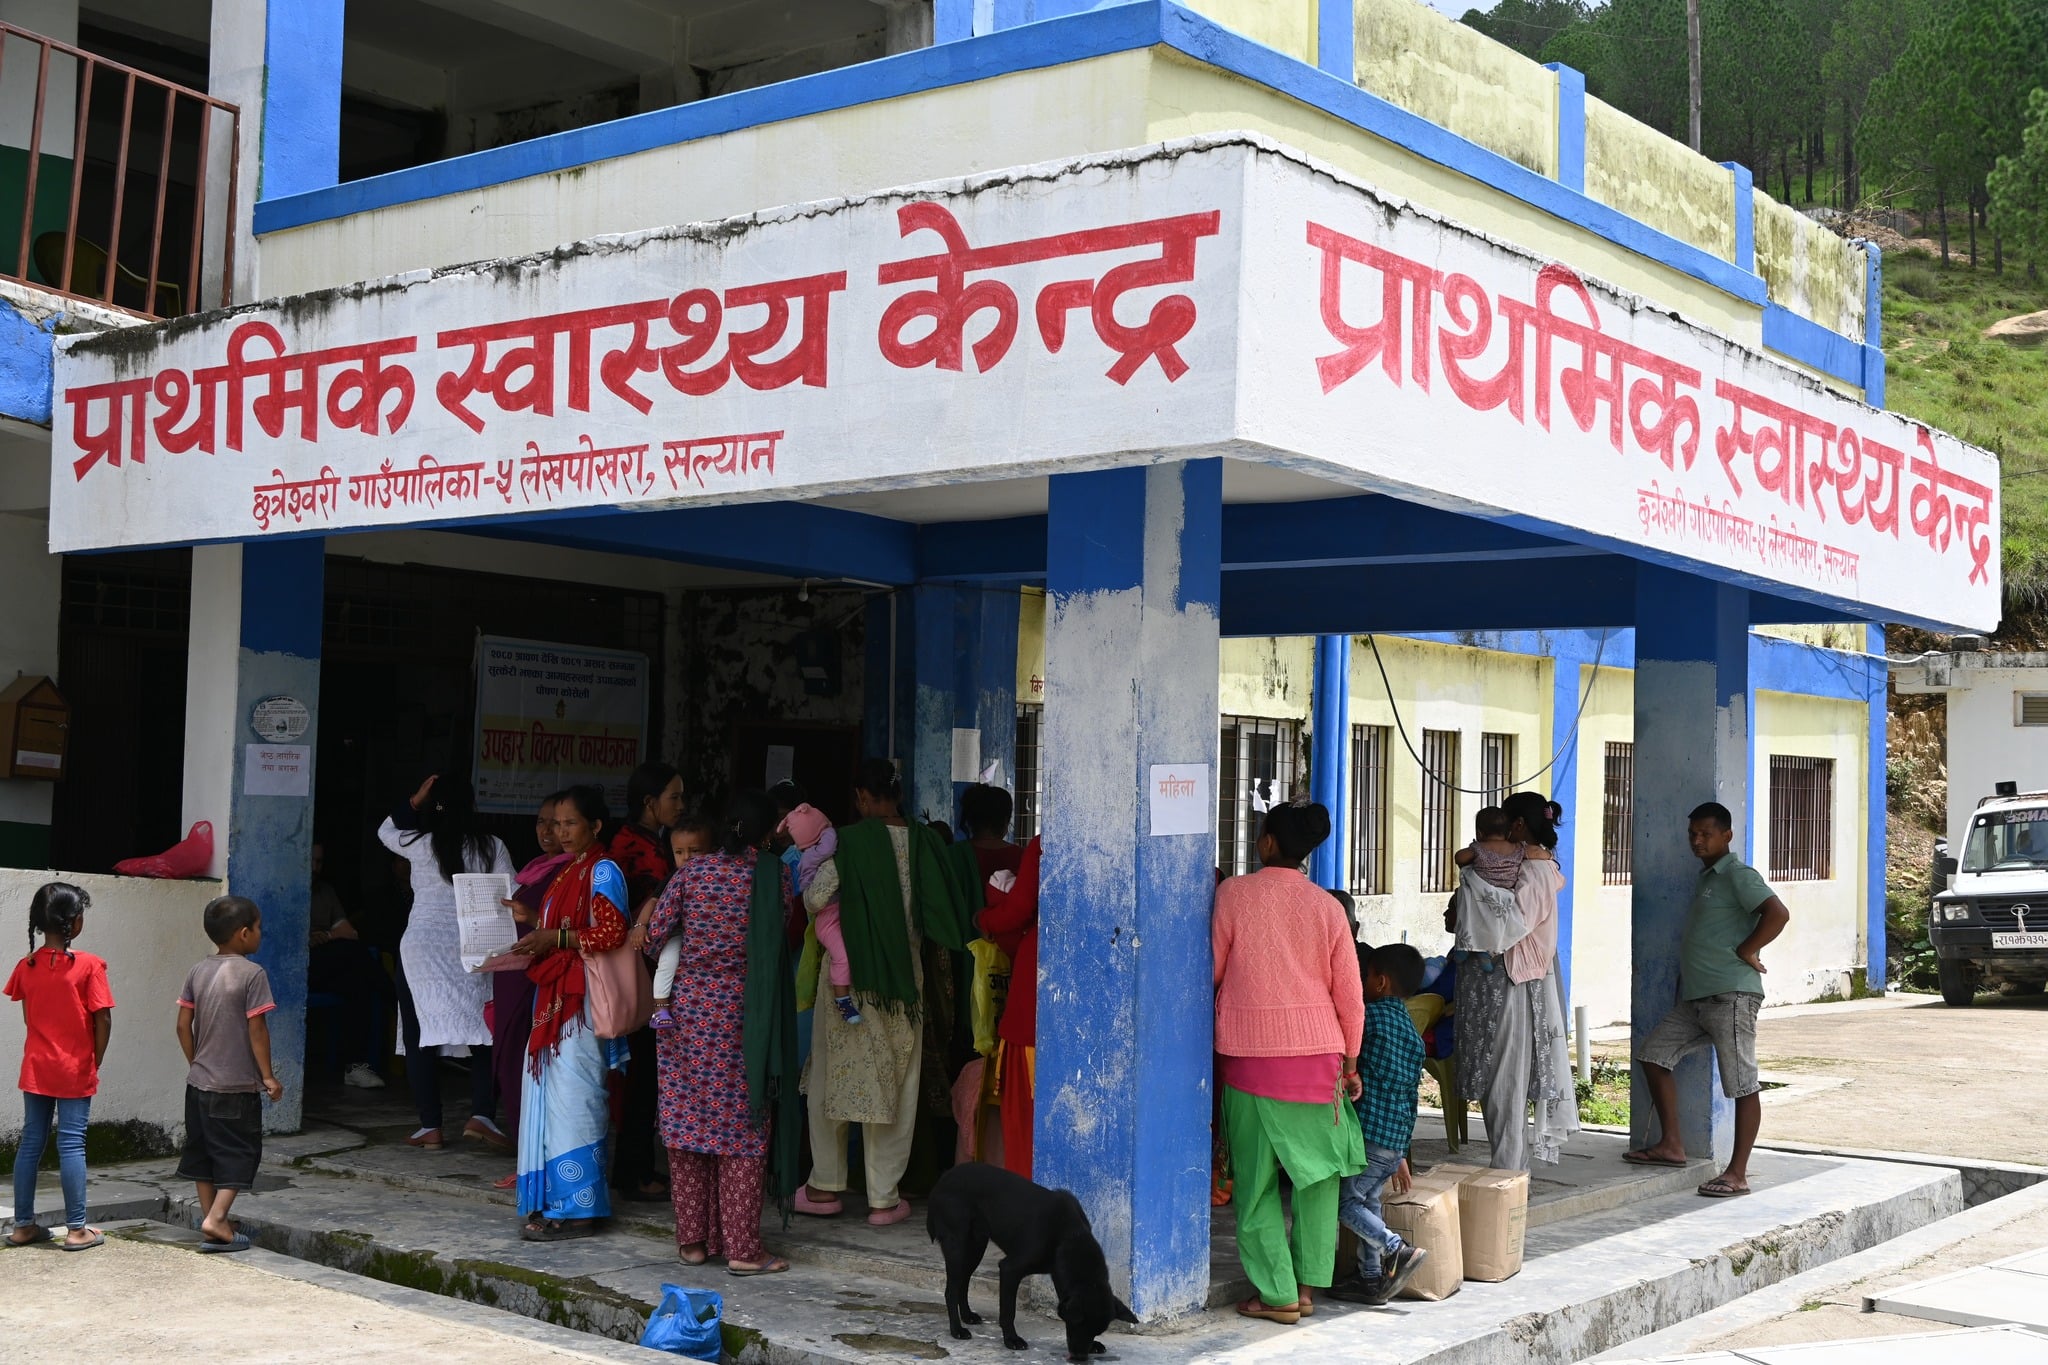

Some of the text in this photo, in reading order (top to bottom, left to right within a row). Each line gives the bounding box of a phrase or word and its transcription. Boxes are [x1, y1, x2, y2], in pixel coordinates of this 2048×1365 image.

[65, 201, 1220, 482] प्राथमिक स्वास्थ्य केन्द्र
[1306, 220, 1993, 587] प्राथमिक स्वास्थ्य केन्द्र
[663, 430, 784, 490] सल्यान
[1823, 544, 1860, 585] सल्यान
[541, 651, 559, 665] देखि
[481, 720, 639, 768] उपहार वितरण कार्यक्रम
[1159, 774, 1196, 799] महिला
